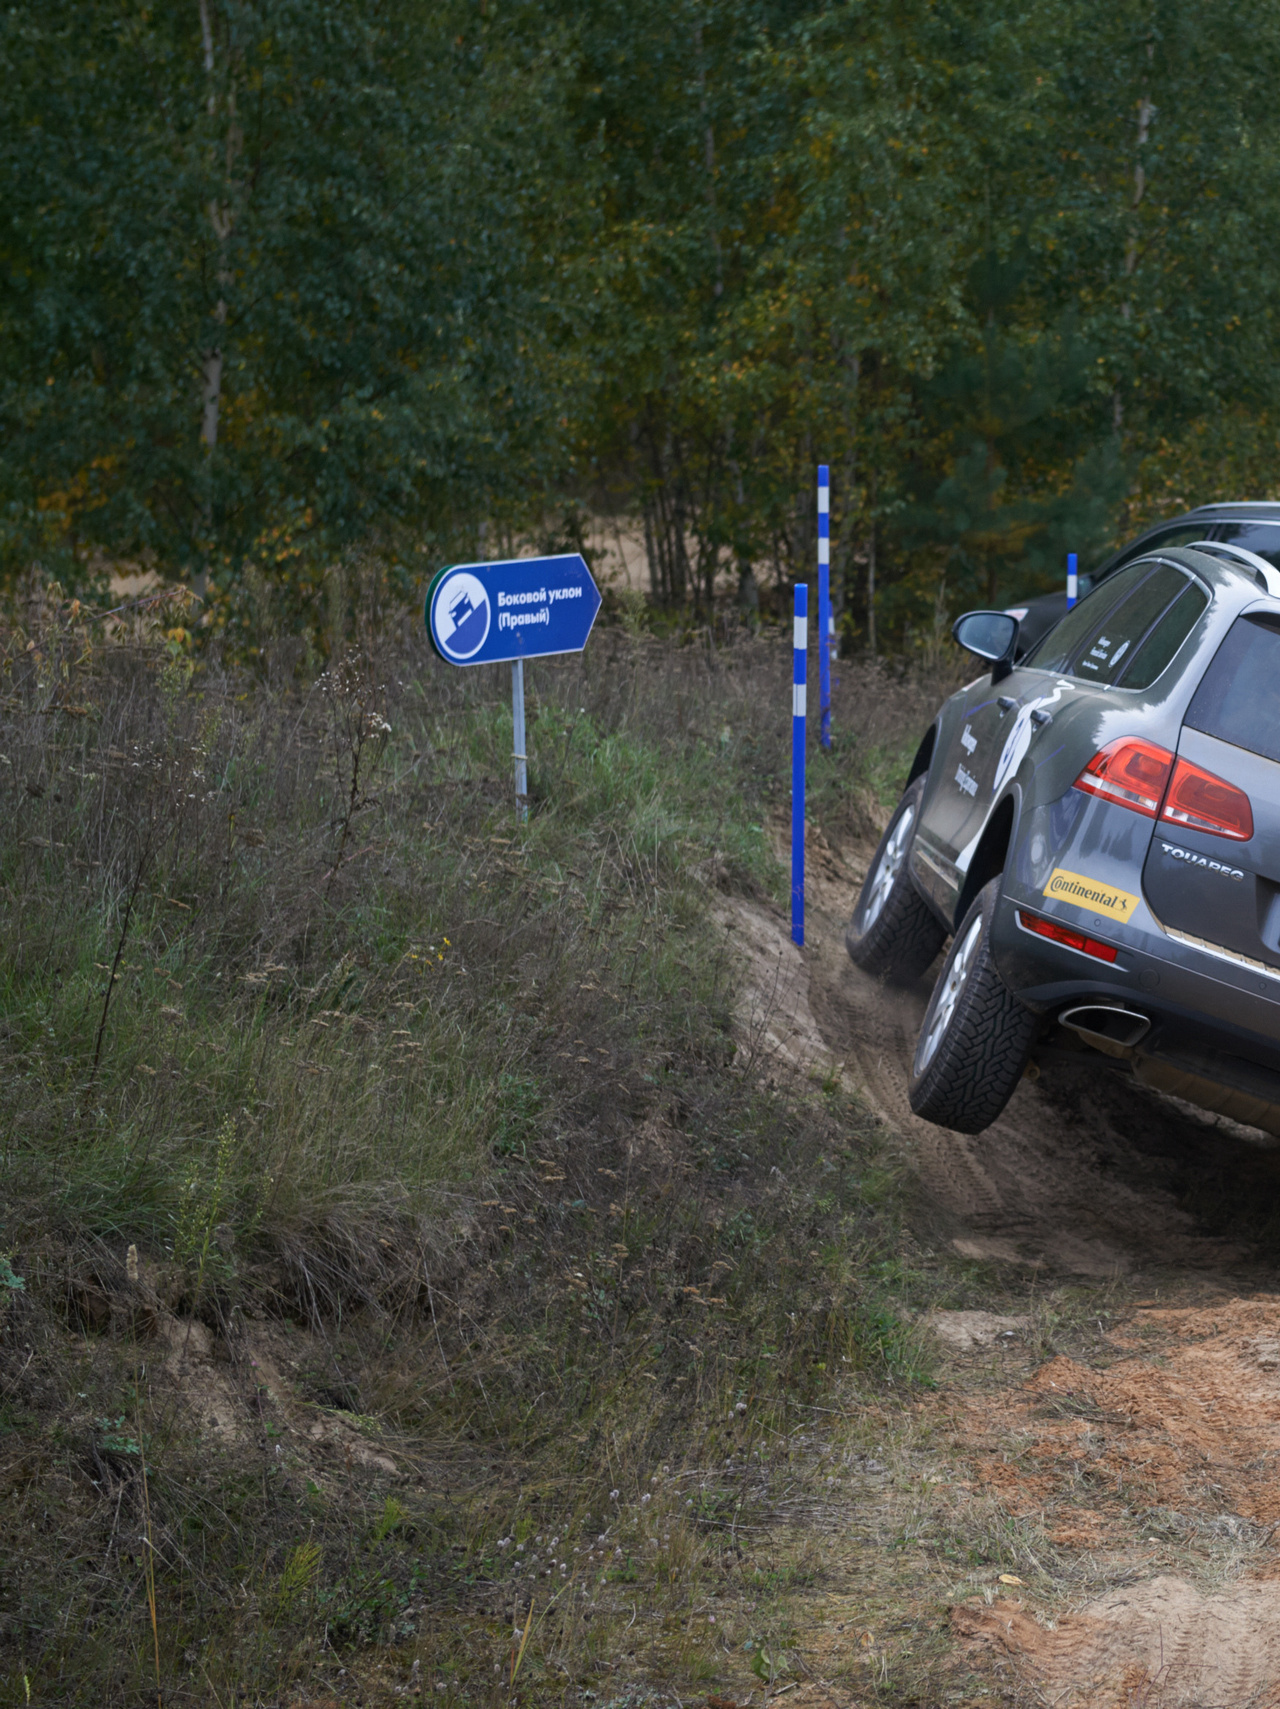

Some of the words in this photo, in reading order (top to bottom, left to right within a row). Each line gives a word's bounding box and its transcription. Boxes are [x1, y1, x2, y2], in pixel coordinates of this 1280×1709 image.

[498, 587, 547, 607] Боковой
[548, 586, 582, 605] уклон
[498, 607, 550, 631] (Правый)
[1162, 843, 1245, 882] TOUAREG
[1050, 875, 1119, 909] Continental
